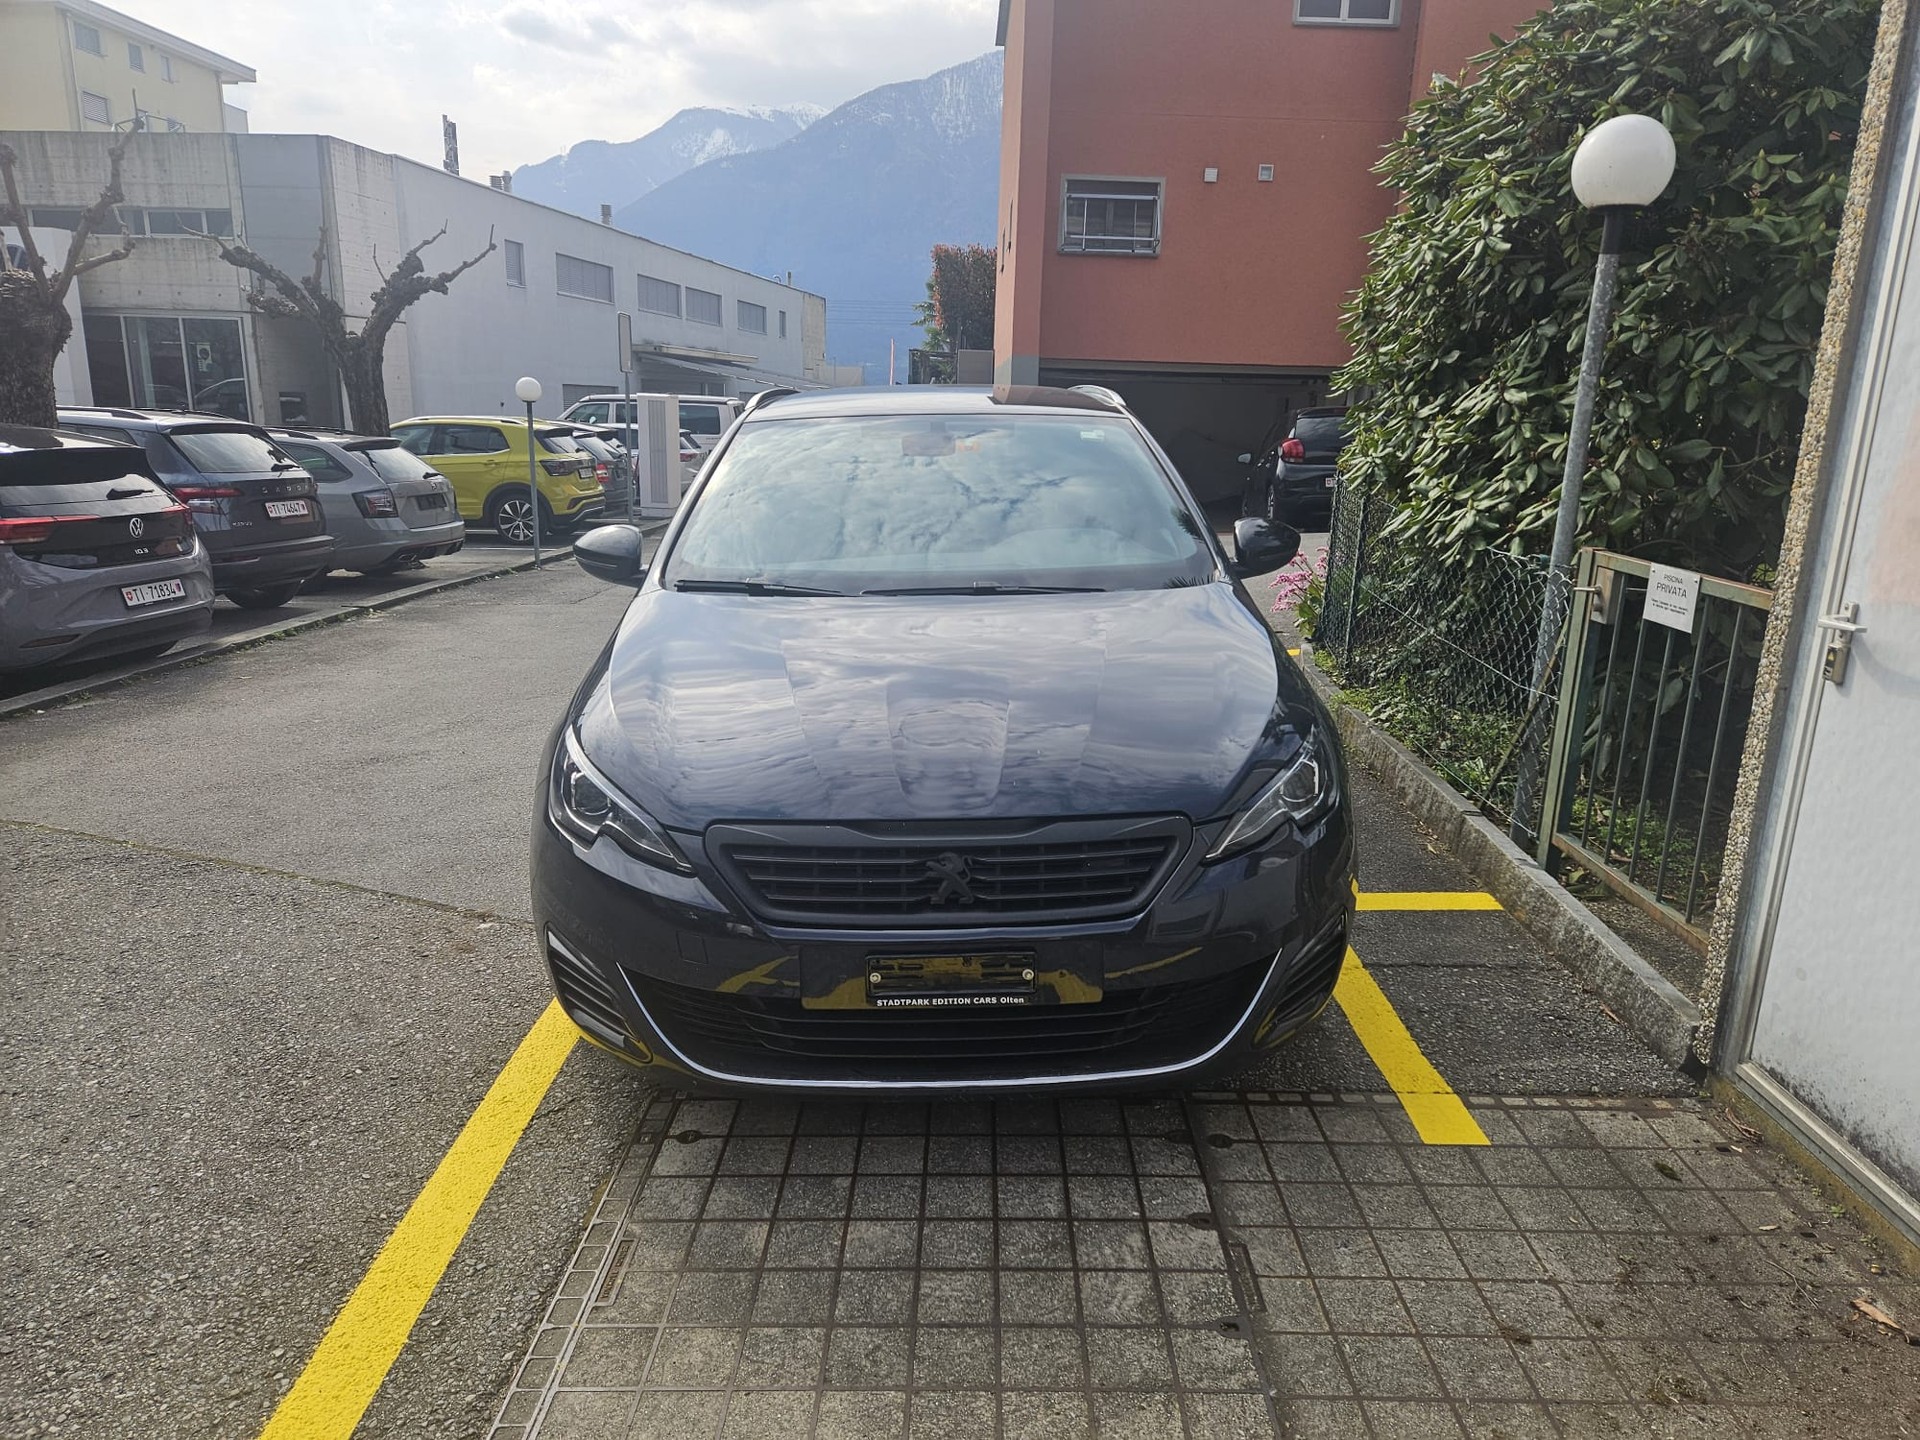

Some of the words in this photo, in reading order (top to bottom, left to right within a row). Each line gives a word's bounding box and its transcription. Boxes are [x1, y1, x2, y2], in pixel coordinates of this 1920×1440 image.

[1656, 582, 1687, 598] PRIVATA
[876, 999, 930, 1007] STADTPARK
[932, 997, 971, 1006] EDITION
[973, 996, 998, 1005] CARS
[1000, 996, 1025, 1004] Olten
